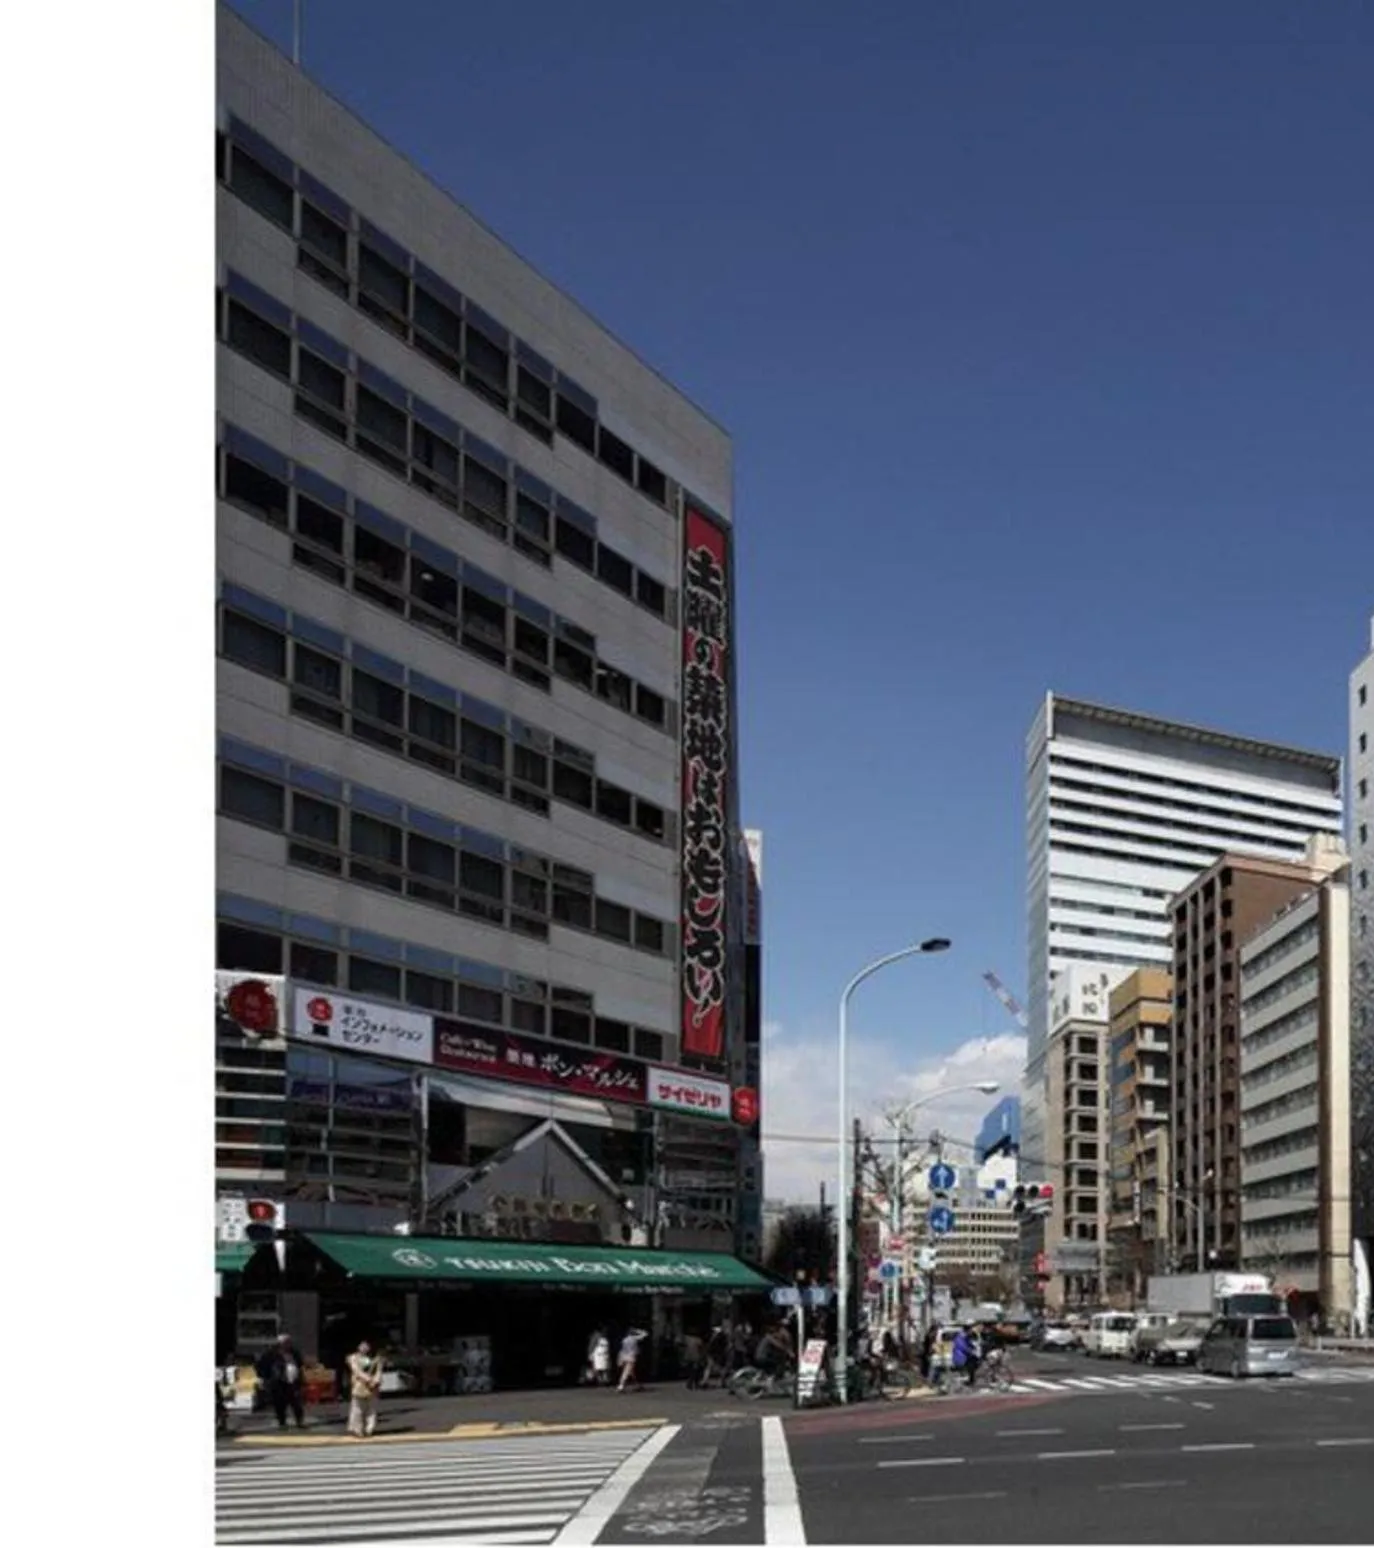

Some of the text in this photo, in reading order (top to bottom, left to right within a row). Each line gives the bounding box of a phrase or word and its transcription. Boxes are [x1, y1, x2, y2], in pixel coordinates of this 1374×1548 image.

[340, 1016, 424, 1042] インフォメーション
[342, 1029, 381, 1045] センター
[658, 1084, 722, 1109] サイゼリヤ
